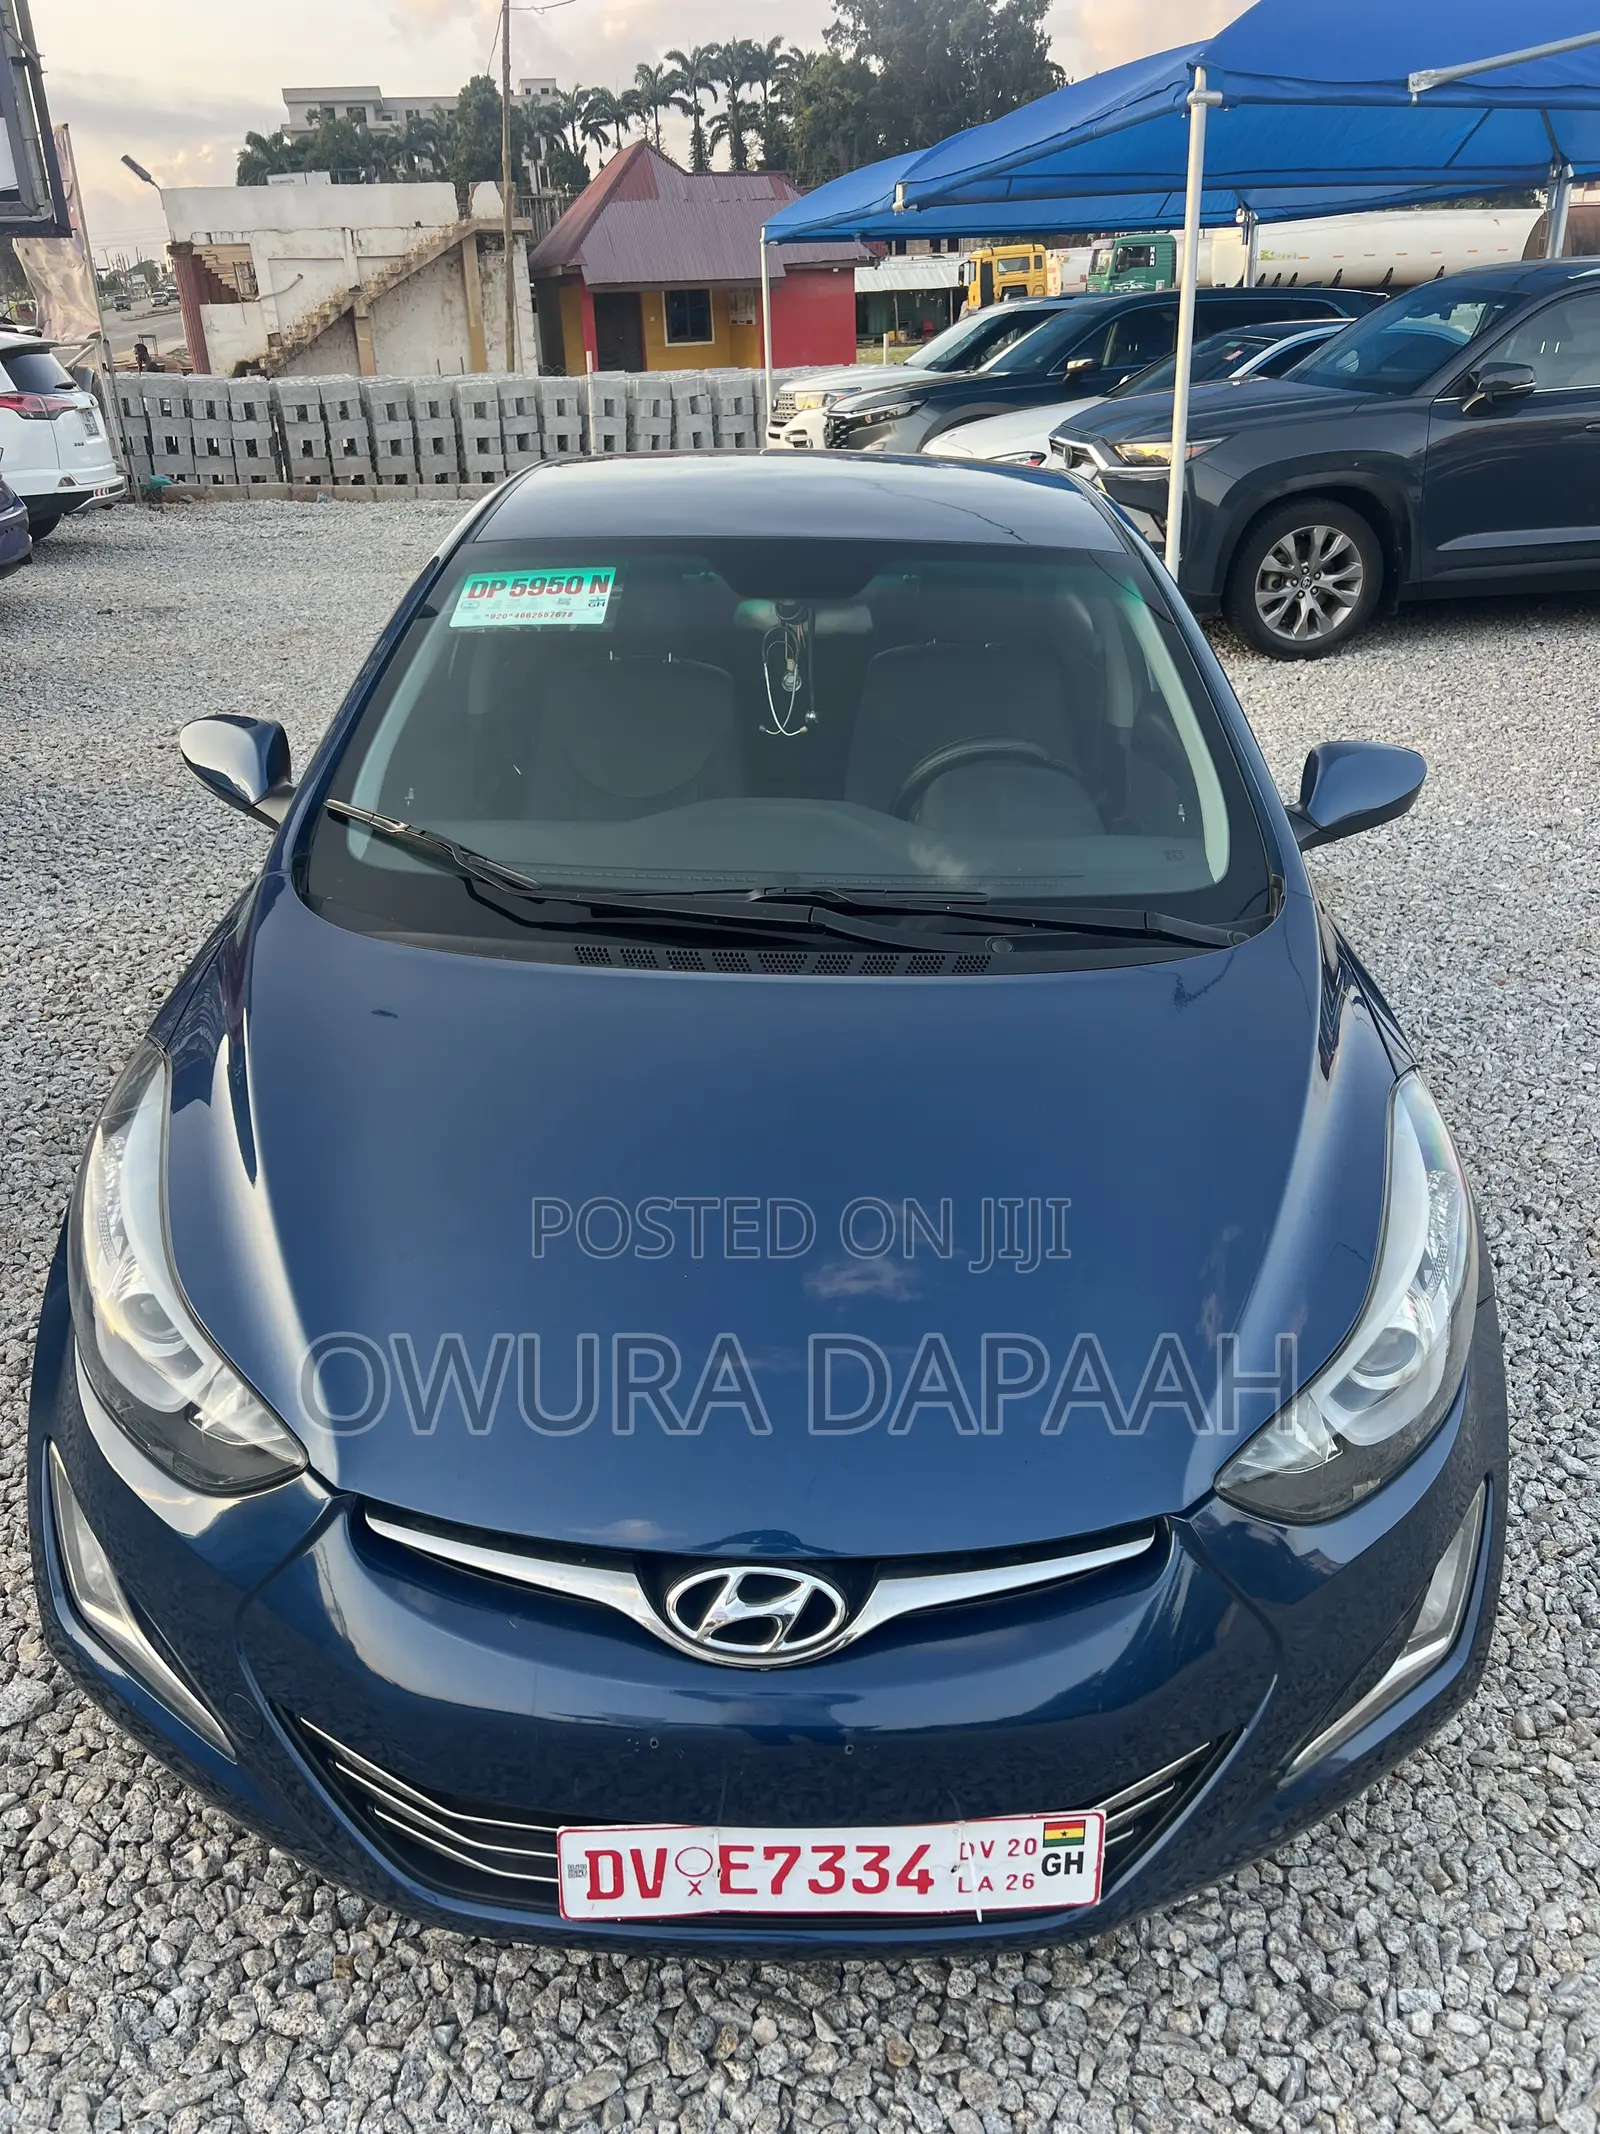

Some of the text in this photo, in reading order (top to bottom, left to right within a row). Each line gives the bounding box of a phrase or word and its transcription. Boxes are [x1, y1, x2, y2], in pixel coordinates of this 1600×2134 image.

[467, 574, 612, 599] DP 5950 N
[959, 1837, 1038, 1861] DV 20
[584, 1843, 936, 1900] DV E7334
[1040, 1850, 1085, 1877] GH
[957, 1872, 1036, 1894] LA 26
